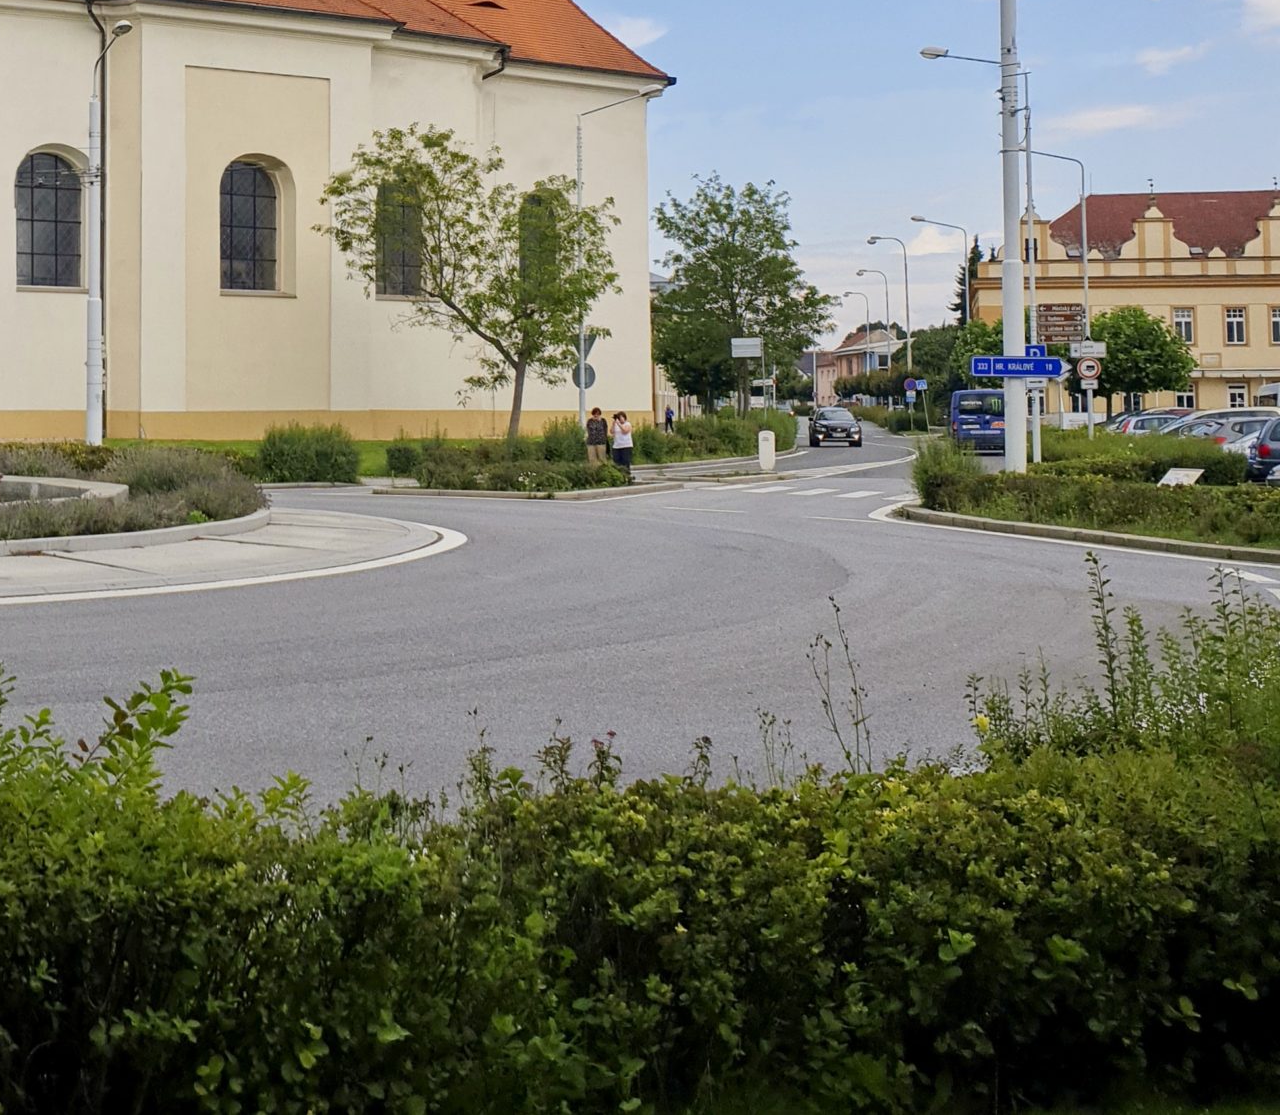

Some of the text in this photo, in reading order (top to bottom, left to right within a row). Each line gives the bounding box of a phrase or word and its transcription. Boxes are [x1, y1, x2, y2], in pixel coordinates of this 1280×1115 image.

[976, 362, 989, 371] 333
[994, 362, 1005, 371] HR.
[1007, 360, 1035, 371] KRÁLOVÉ
